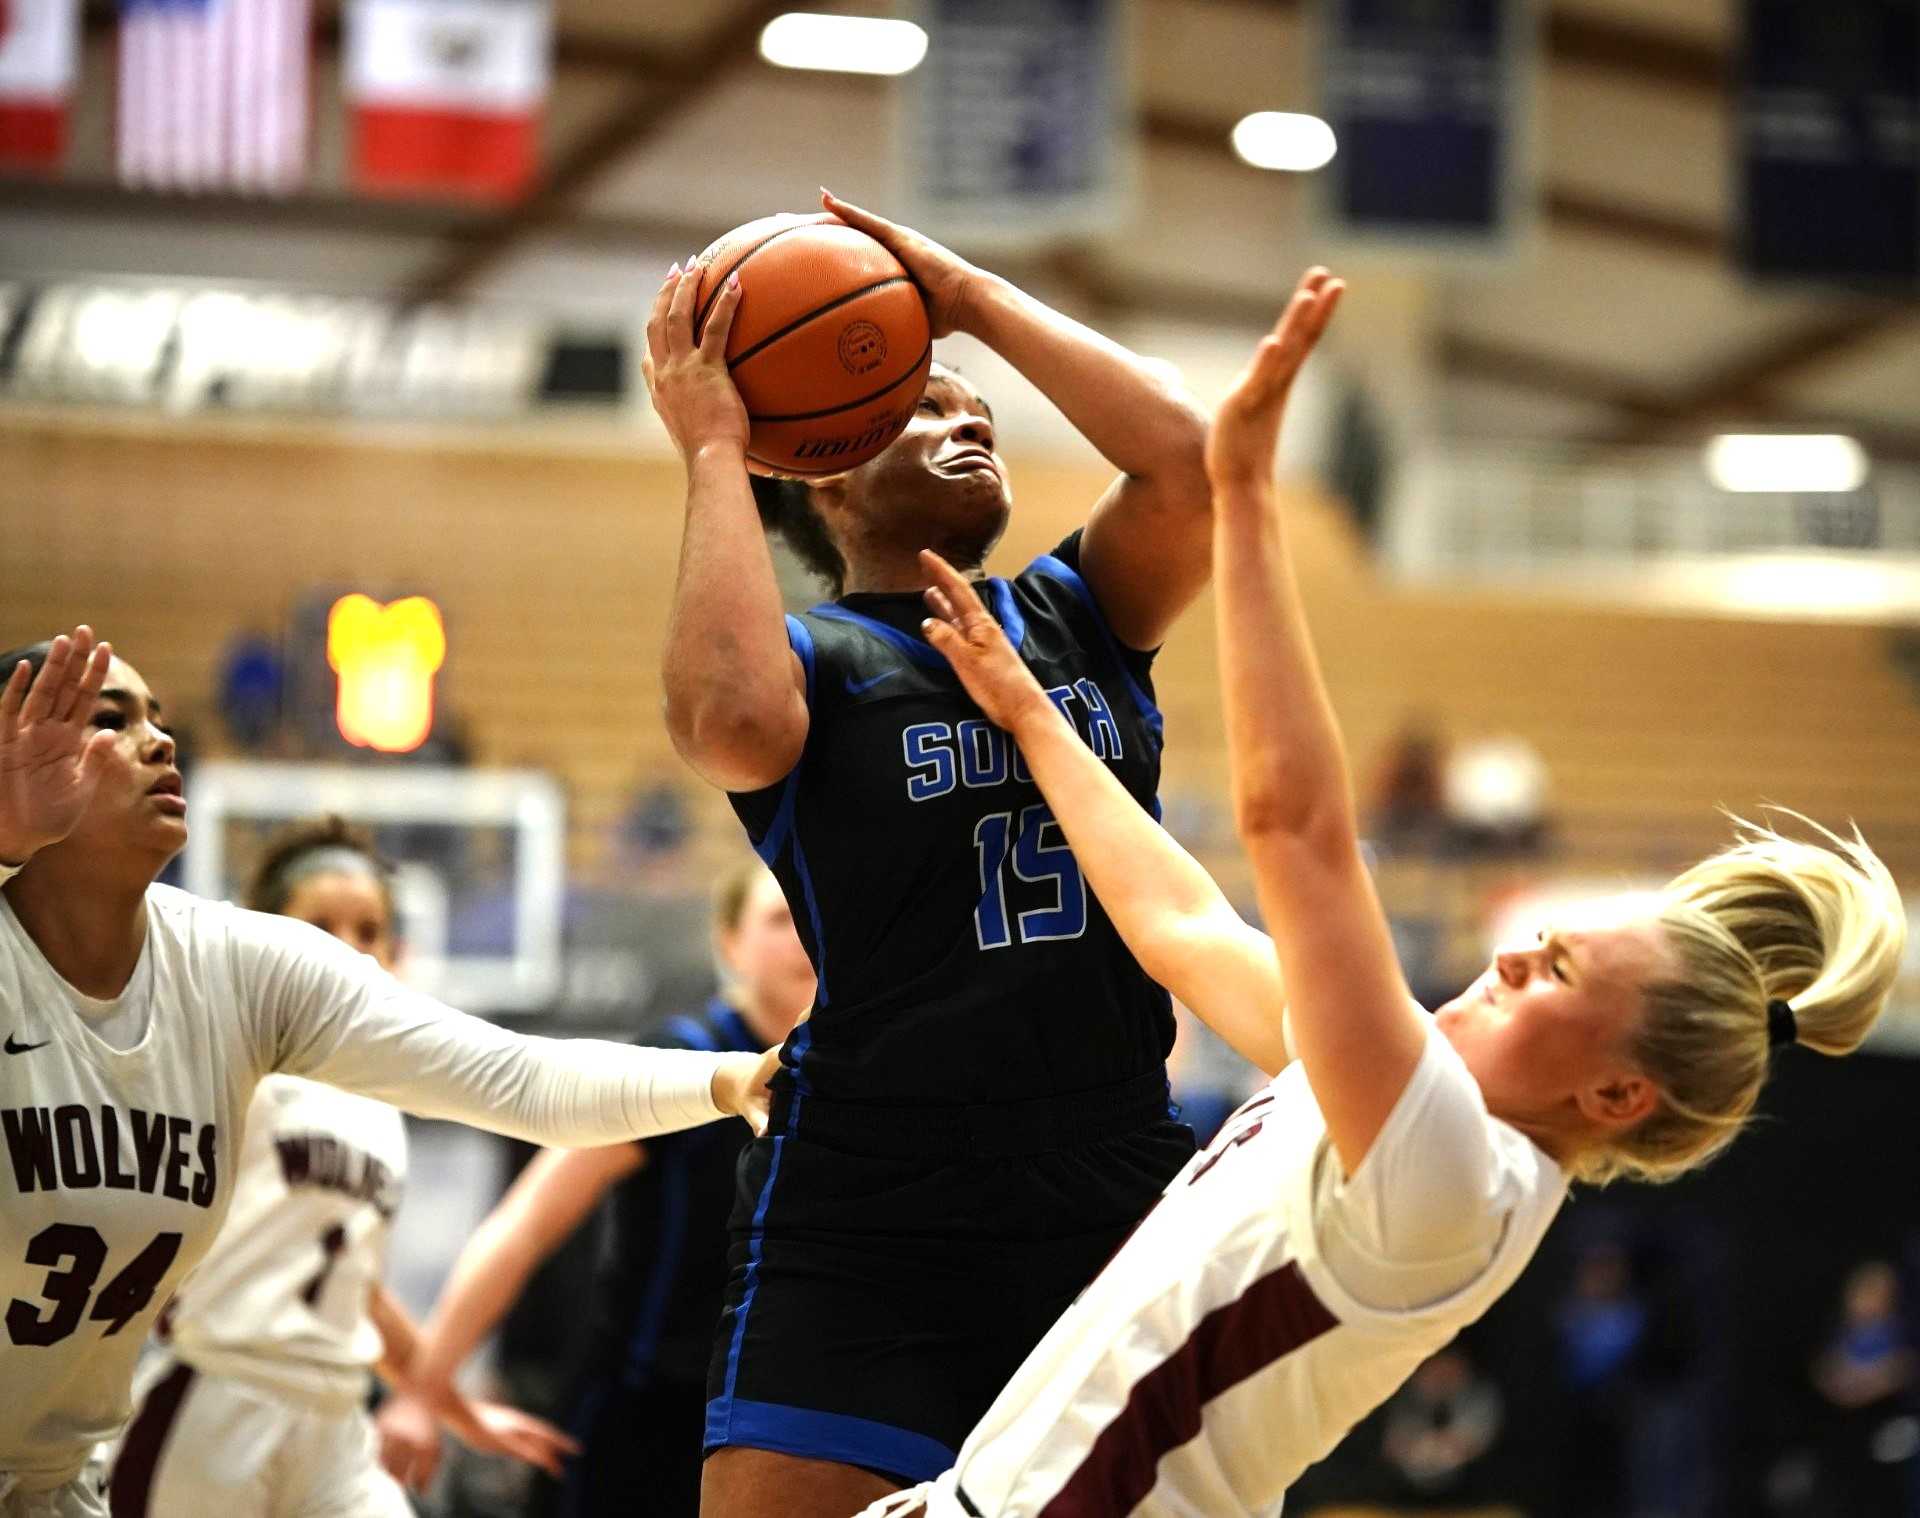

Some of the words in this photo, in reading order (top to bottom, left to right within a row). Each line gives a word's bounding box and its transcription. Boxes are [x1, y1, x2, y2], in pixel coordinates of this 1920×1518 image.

[902, 677, 1123, 802] SOH
[973, 804, 1087, 951] 15
[1, 1104, 216, 1208] WOLVES
[5, 1223, 183, 1347] 34
